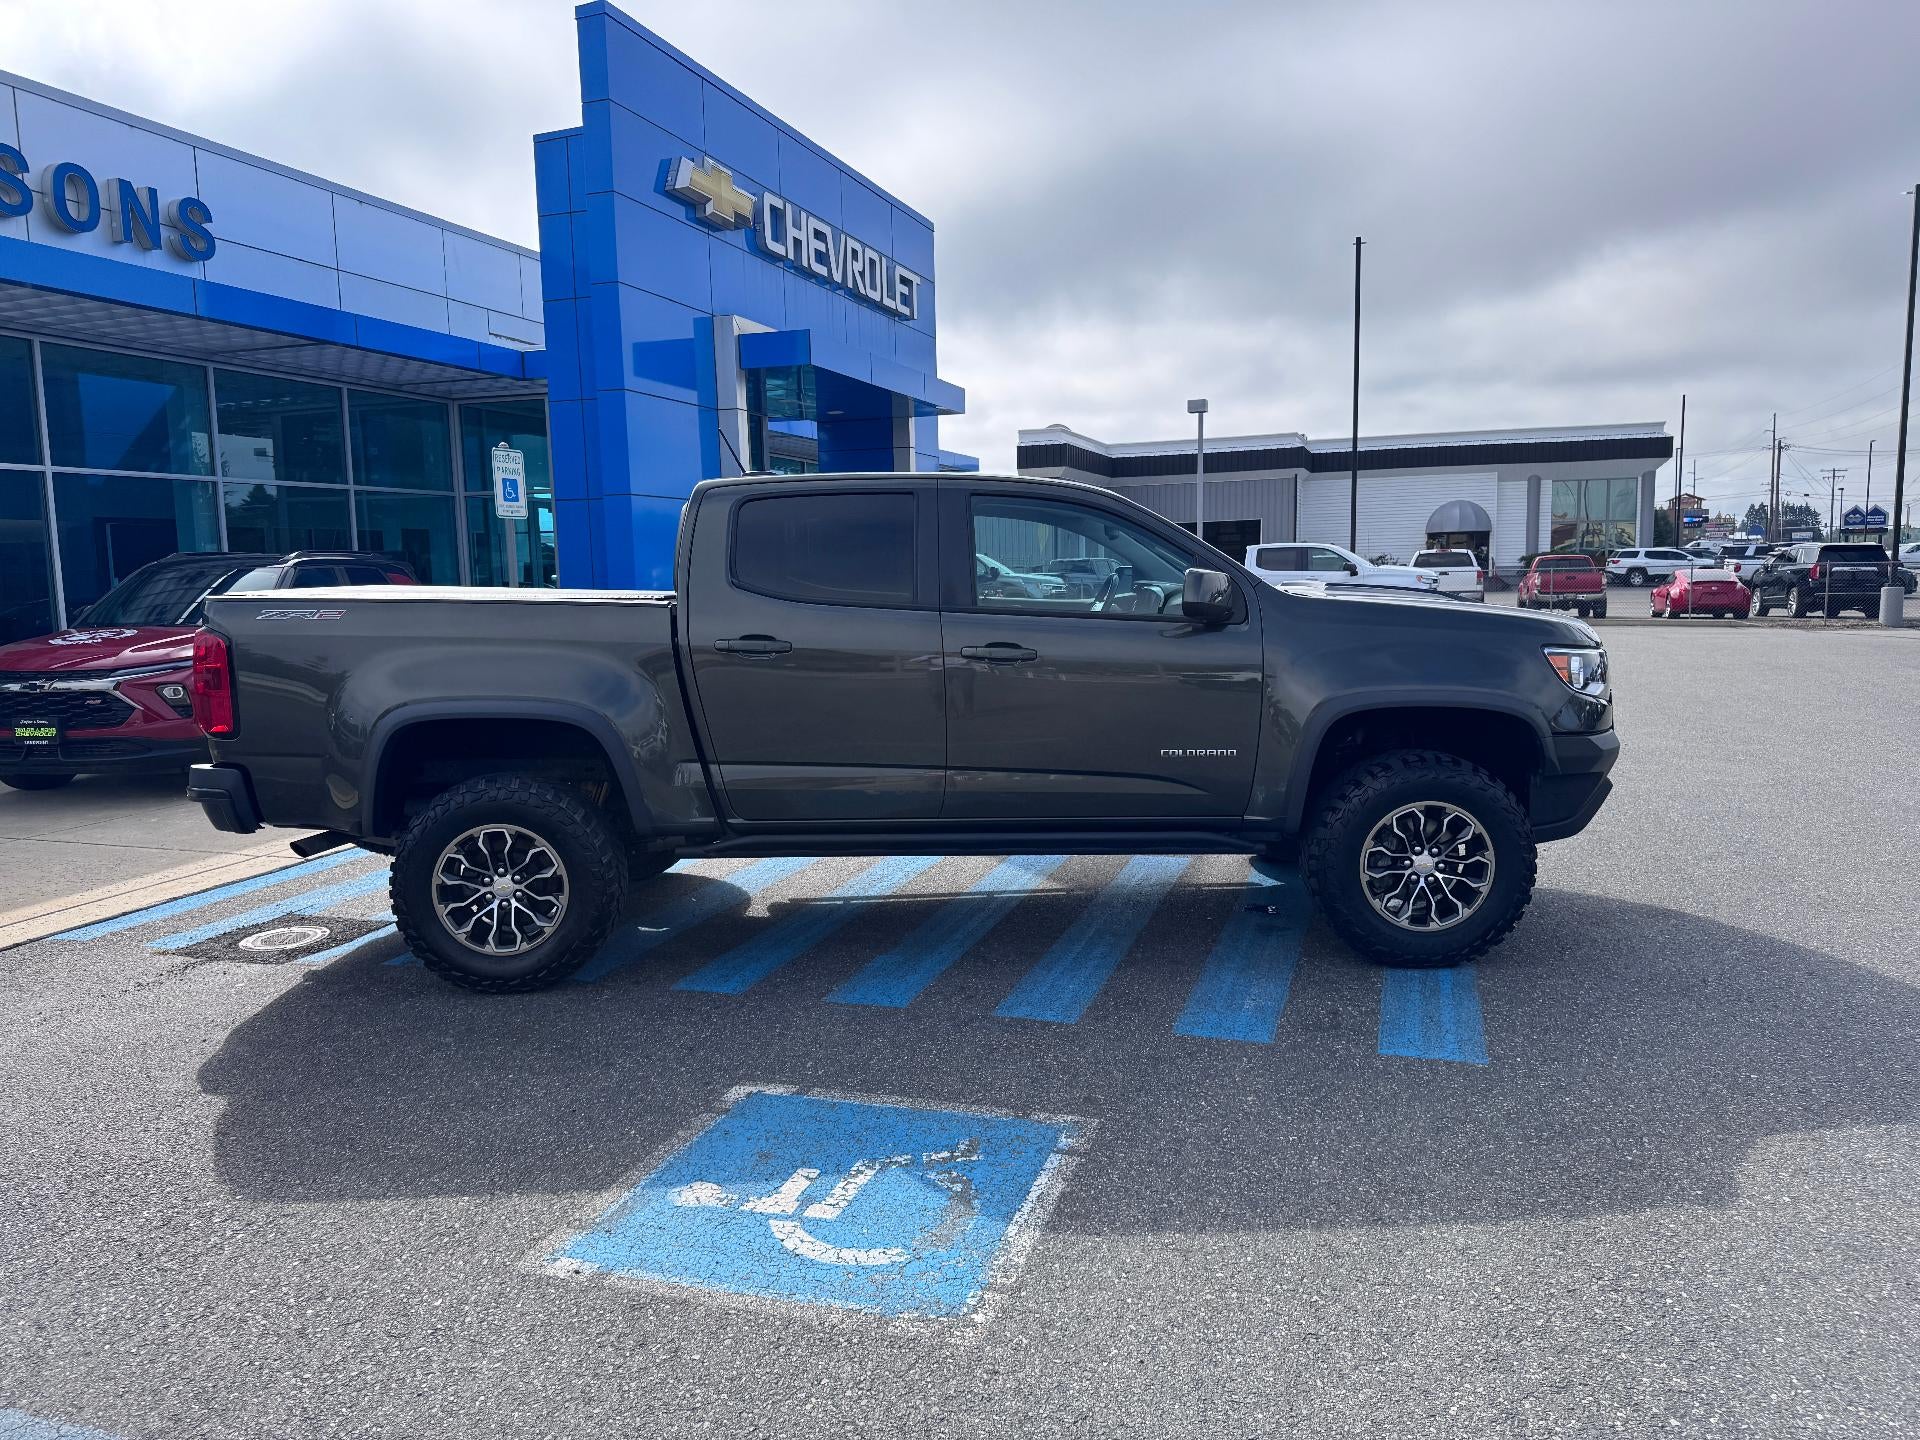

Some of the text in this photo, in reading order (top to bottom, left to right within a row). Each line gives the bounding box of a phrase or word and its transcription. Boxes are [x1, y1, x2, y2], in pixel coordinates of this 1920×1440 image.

[0, 142, 216, 262] SONS
[763, 191, 921, 320] CHEVROLET
[256, 609, 347, 620] ZR2
[1160, 749, 1237, 758] COLORADO
